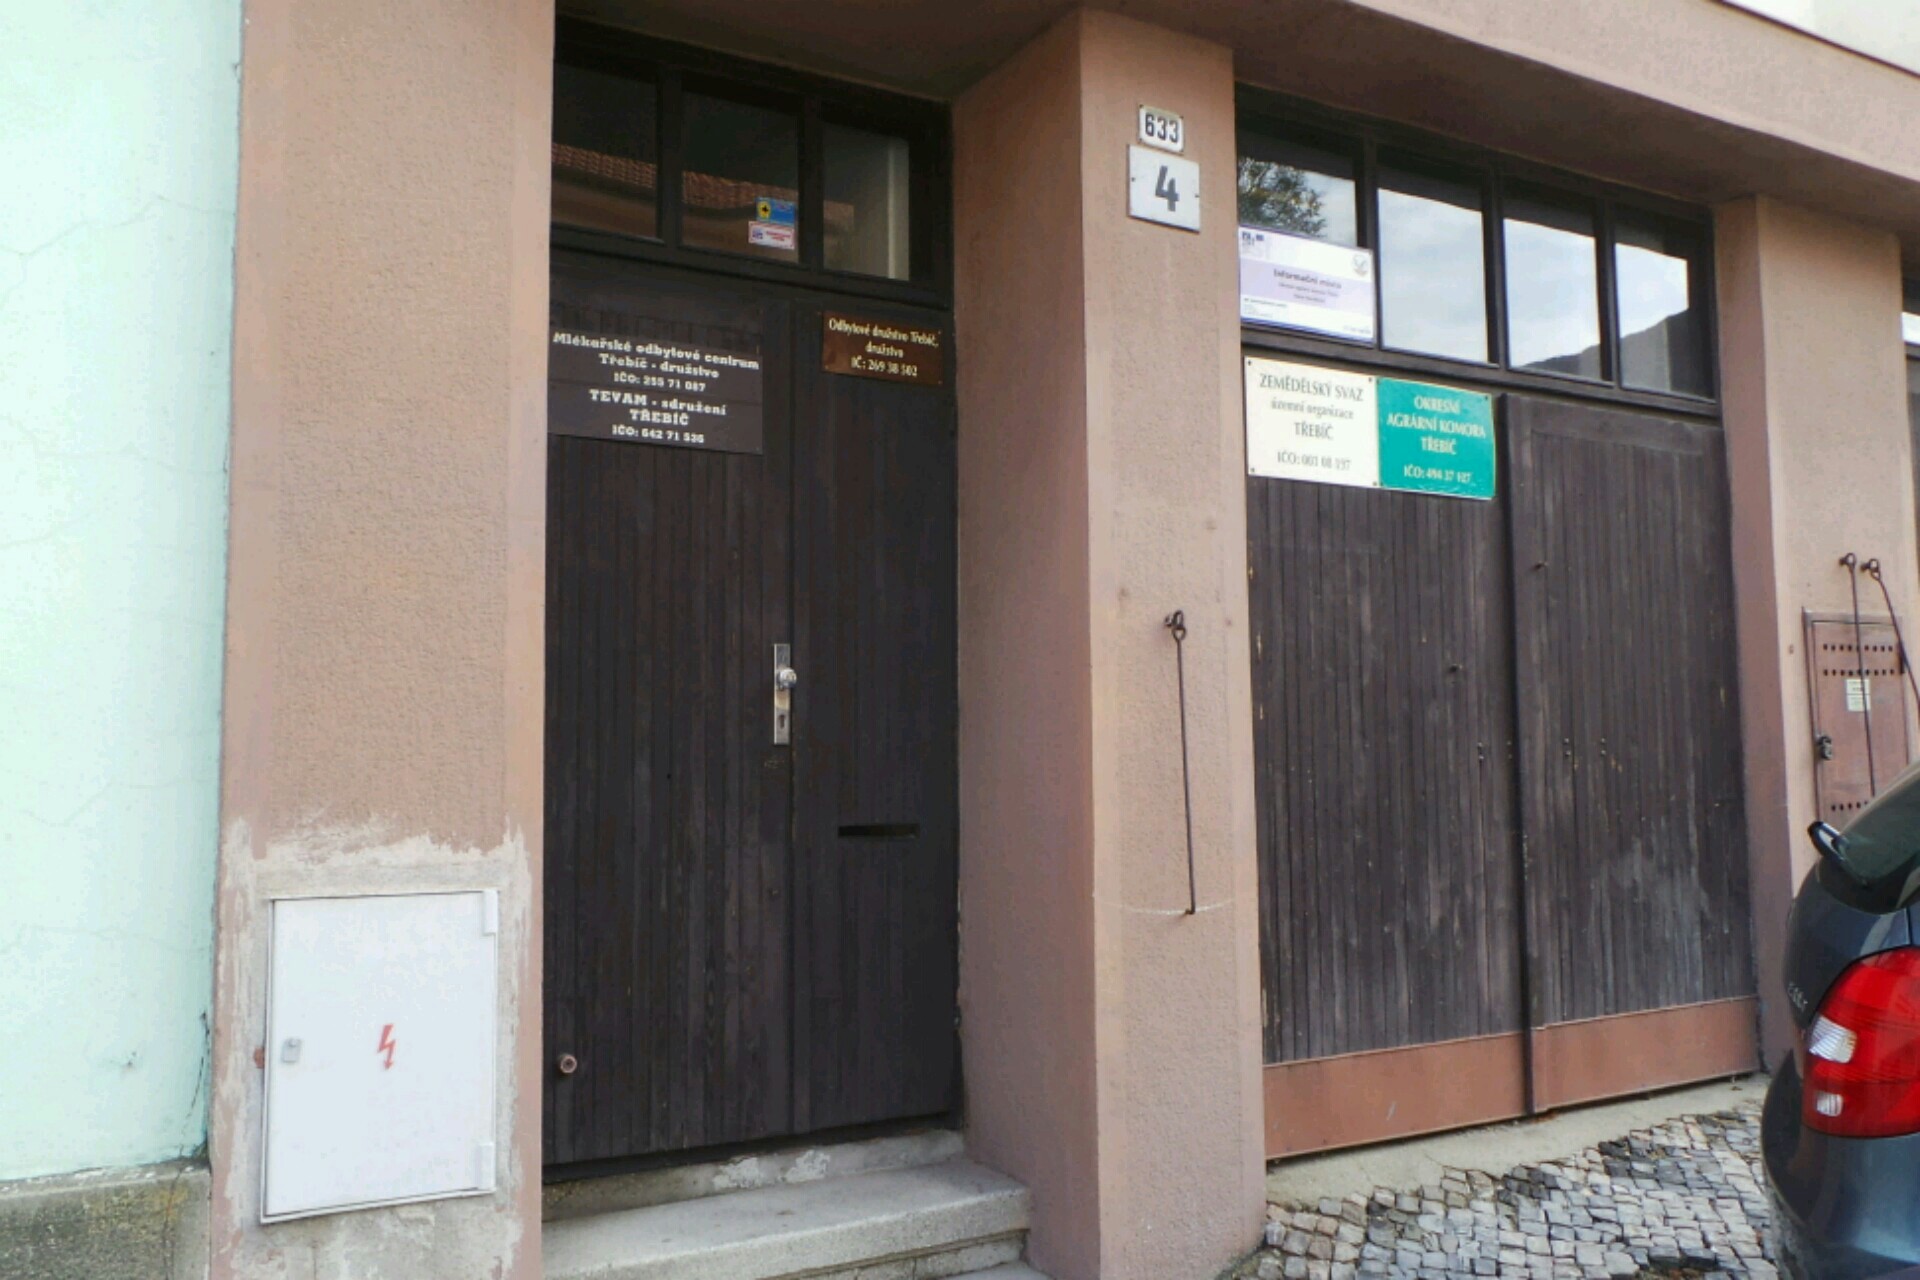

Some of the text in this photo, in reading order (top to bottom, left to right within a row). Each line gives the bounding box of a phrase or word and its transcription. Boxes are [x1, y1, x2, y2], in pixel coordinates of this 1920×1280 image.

[1145, 113, 1179, 143] 633
[1155, 165, 1179, 212] 4
[553, 331, 760, 371] Mlékařské odbytové centrum
[599, 353, 648, 369] Třebíč
[659, 361, 720, 378] družstvo
[613, 371, 640, 384] IČO:
[668, 377, 681, 389] 71
[1259, 374, 1364, 402] ZEMĚDĚLSKÝ SVAZ
[589, 388, 648, 406] TEVAM
[661, 398, 727, 416] sdružení
[1271, 398, 1354, 420] územní organizace
[629, 408, 690, 426] TŘEBÍČ
[1386, 412, 1486, 440] AGRÁRNÍ KOMORA
[612, 423, 639, 437] IČO:
[666, 430, 680, 442] 71
[1294, 421, 1334, 440] TŘEBÍČ
[1421, 436, 1457, 456] TŘEBÍČ
[1277, 450, 1300, 466] IČO:
[1404, 463, 1425, 479] IČO:
